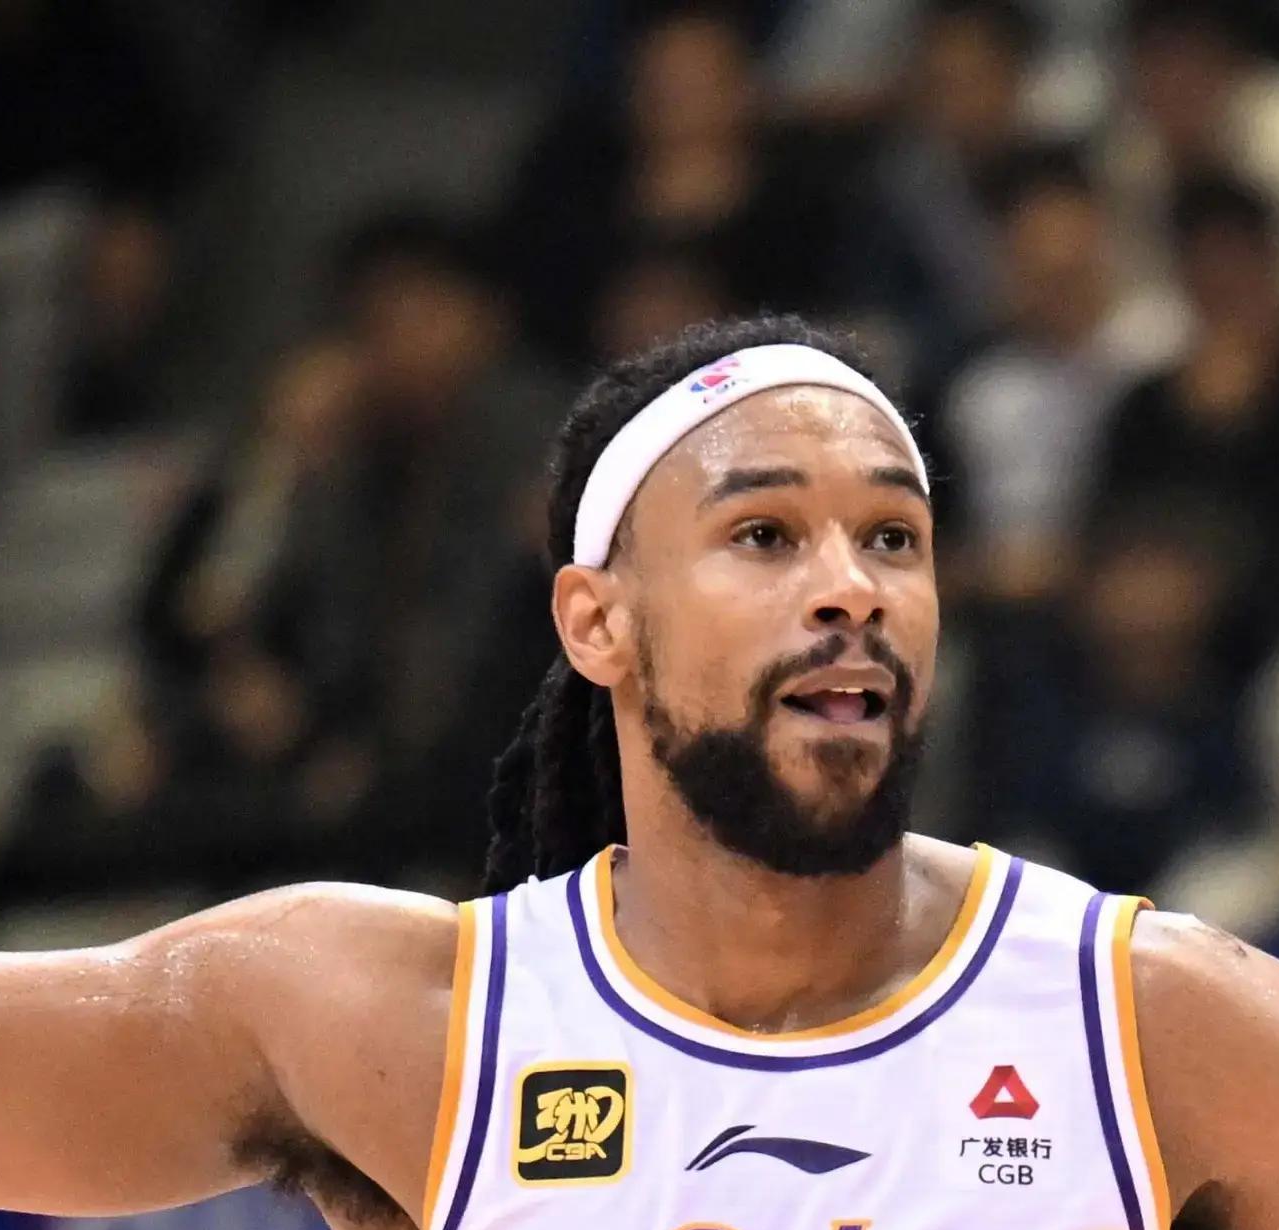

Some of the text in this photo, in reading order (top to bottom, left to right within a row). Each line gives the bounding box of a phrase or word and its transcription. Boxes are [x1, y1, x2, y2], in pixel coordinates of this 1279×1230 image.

[960, 1137, 1052, 1159] 广发银行
[978, 1164, 1034, 1185] CGB
